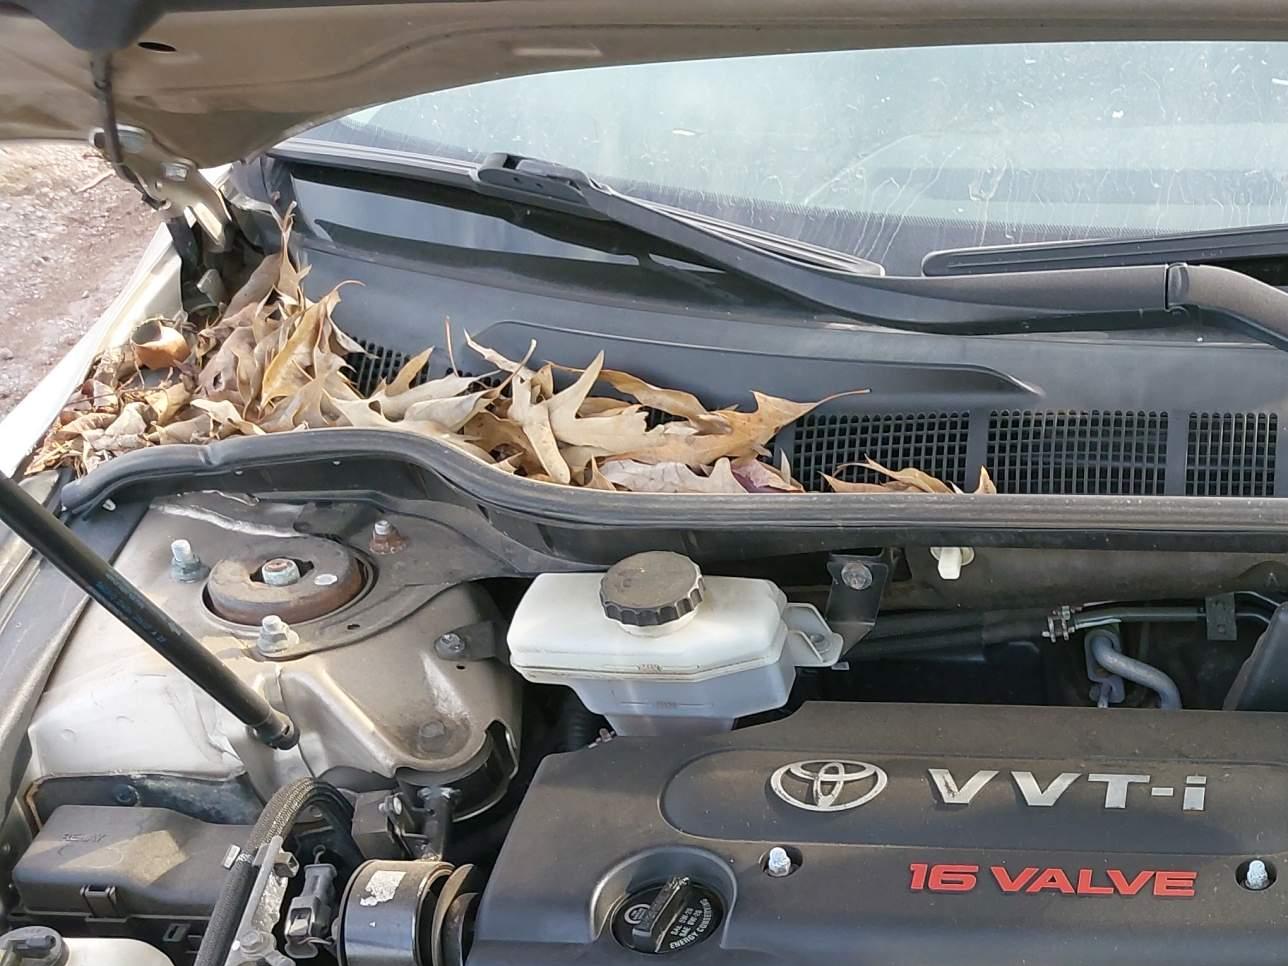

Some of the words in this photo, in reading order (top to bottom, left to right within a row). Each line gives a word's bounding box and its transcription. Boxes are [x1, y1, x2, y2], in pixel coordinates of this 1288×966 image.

[928, 768, 1207, 811] VVT-i
[909, 863, 980, 892] 16
[990, 866, 1199, 897] VALVE
[669, 931, 699, 949] ENERGY
